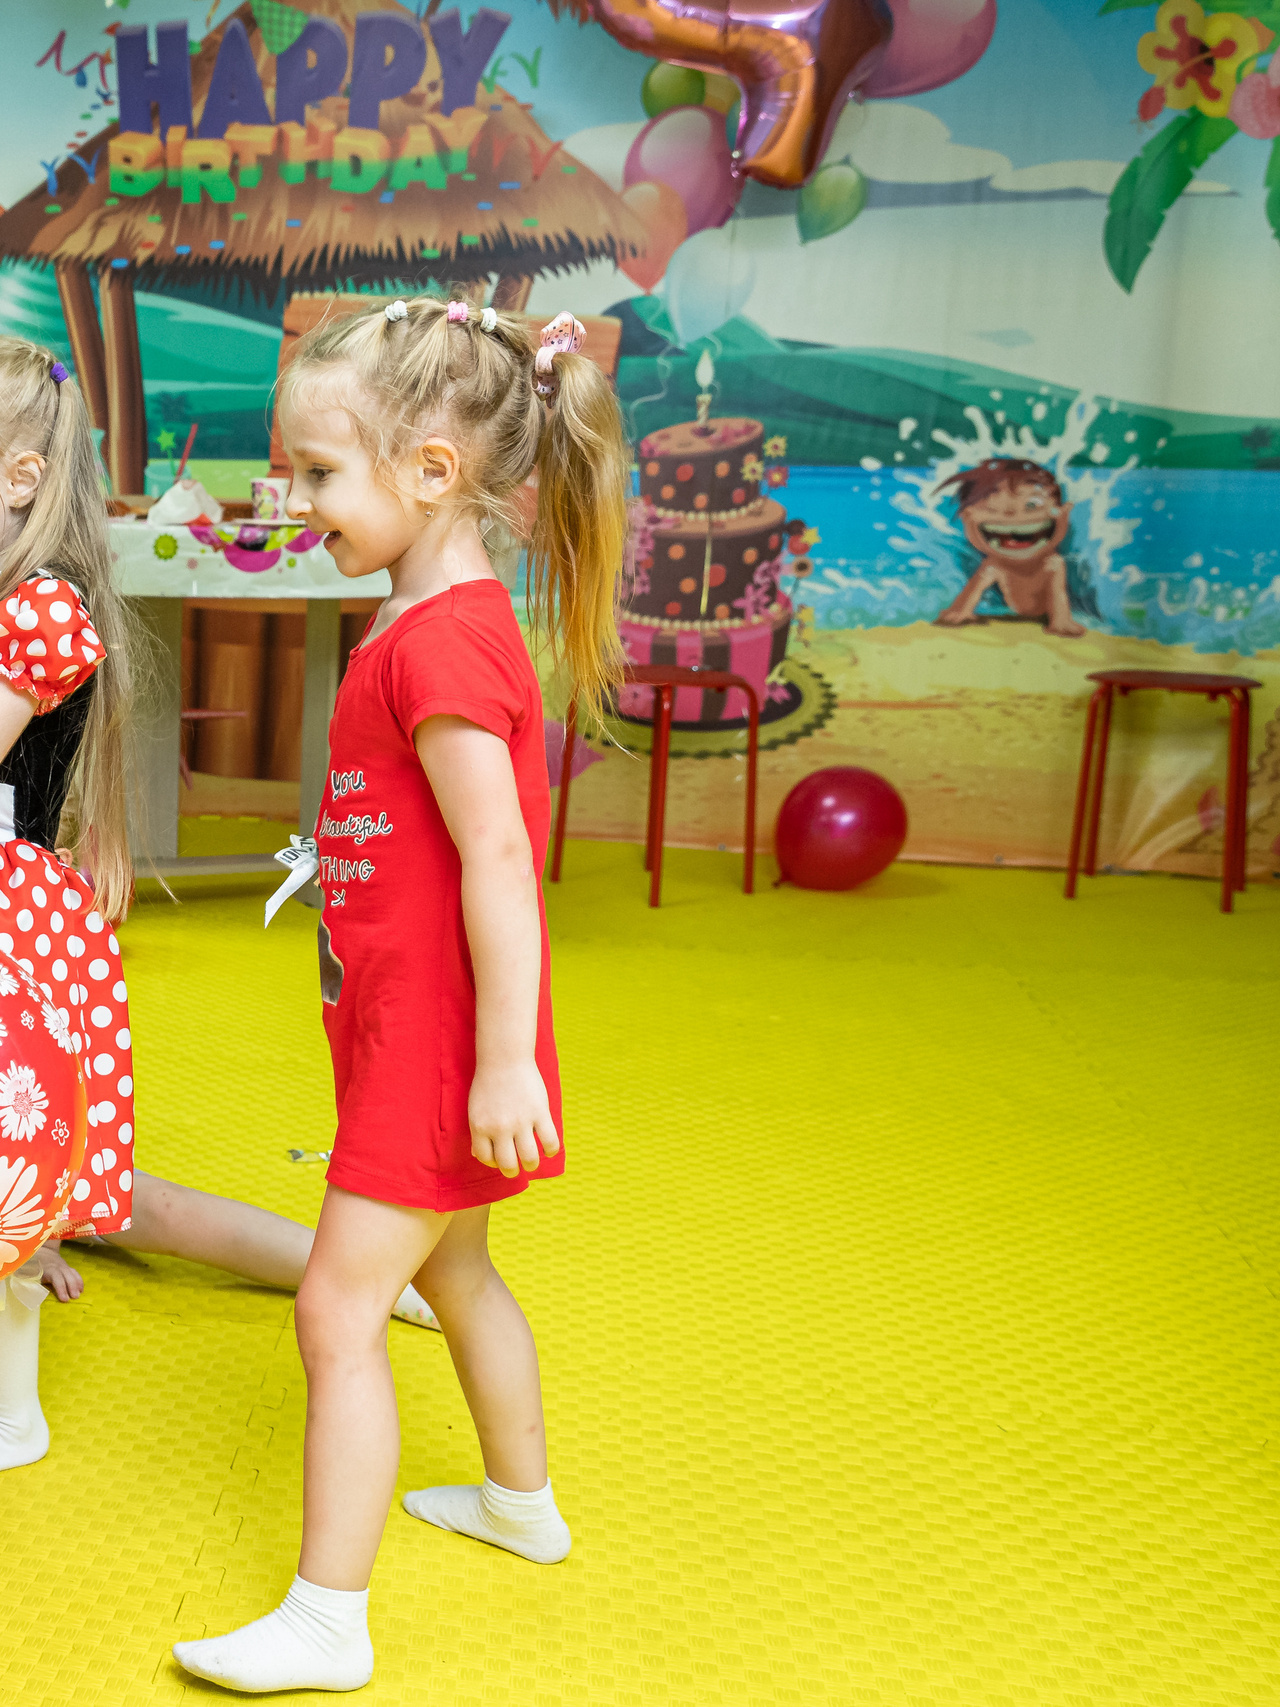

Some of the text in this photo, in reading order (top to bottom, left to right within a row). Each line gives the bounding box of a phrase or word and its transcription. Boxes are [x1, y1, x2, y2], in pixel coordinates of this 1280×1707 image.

[116, 7, 512, 140] HAPPY
[108, 106, 489, 204] BIRTHDAY
[319, 809, 393, 845] beautiful
[320, 856, 376, 882] THING
